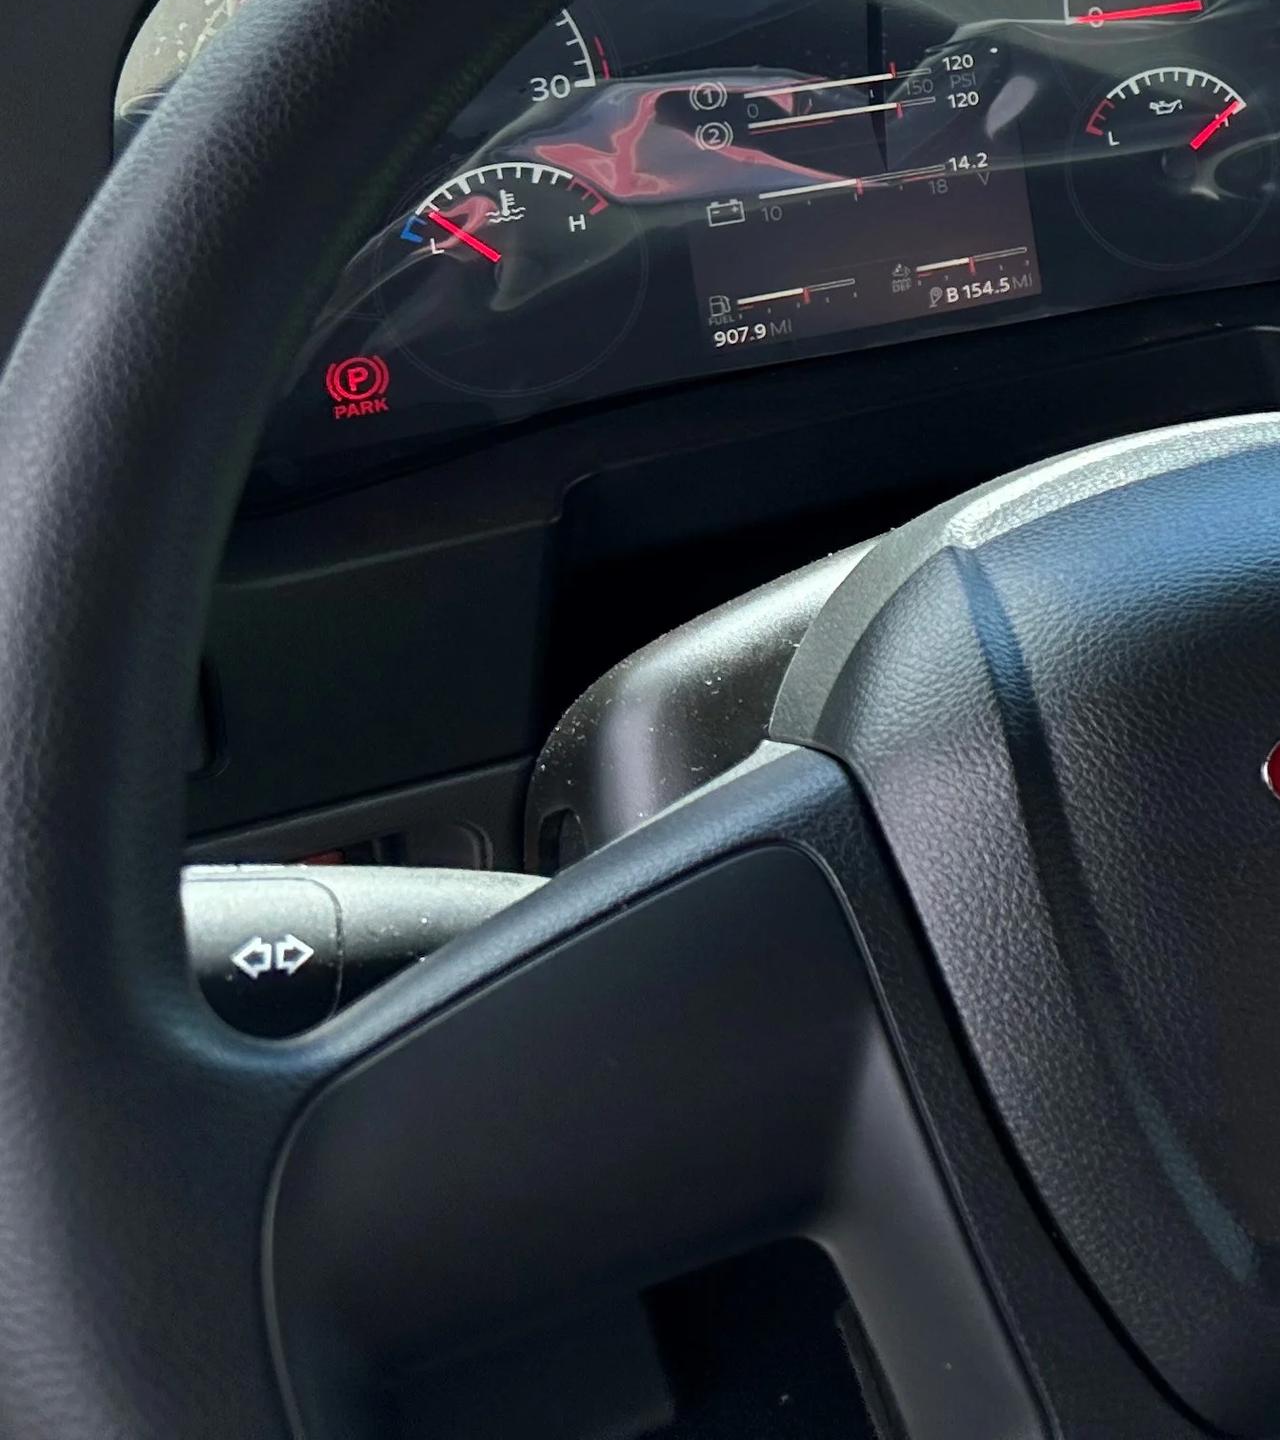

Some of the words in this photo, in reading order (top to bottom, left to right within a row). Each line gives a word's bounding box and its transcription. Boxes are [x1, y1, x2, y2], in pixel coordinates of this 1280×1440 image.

[1087, 6, 1104, 28] 0
[943, 54, 974, 72] 120
[530, 74, 570, 102] 30
[905, 78, 932, 97] 150
[949, 72, 976, 90] PSI
[947, 91, 980, 109] 120
[747, 103, 759, 119] 0
[1108, 131, 1120, 146] L
[949, 152, 988, 171] 14.2
[928, 179, 948, 195] 18
[977, 172, 991, 187] V
[761, 206, 783, 221] 10
[568, 214, 586, 232] H
[430, 238, 444, 255] L
[946, 286, 960, 304] B
[961, 277, 1011, 300] 154.5
[1012, 274, 1033, 291] MI
[708, 313, 735, 327] FUEL
[714, 323, 767, 348] 907.9
[770, 319, 792, 337] MI
[347, 367, 369, 392] P
[333, 396, 389, 420] PARK
